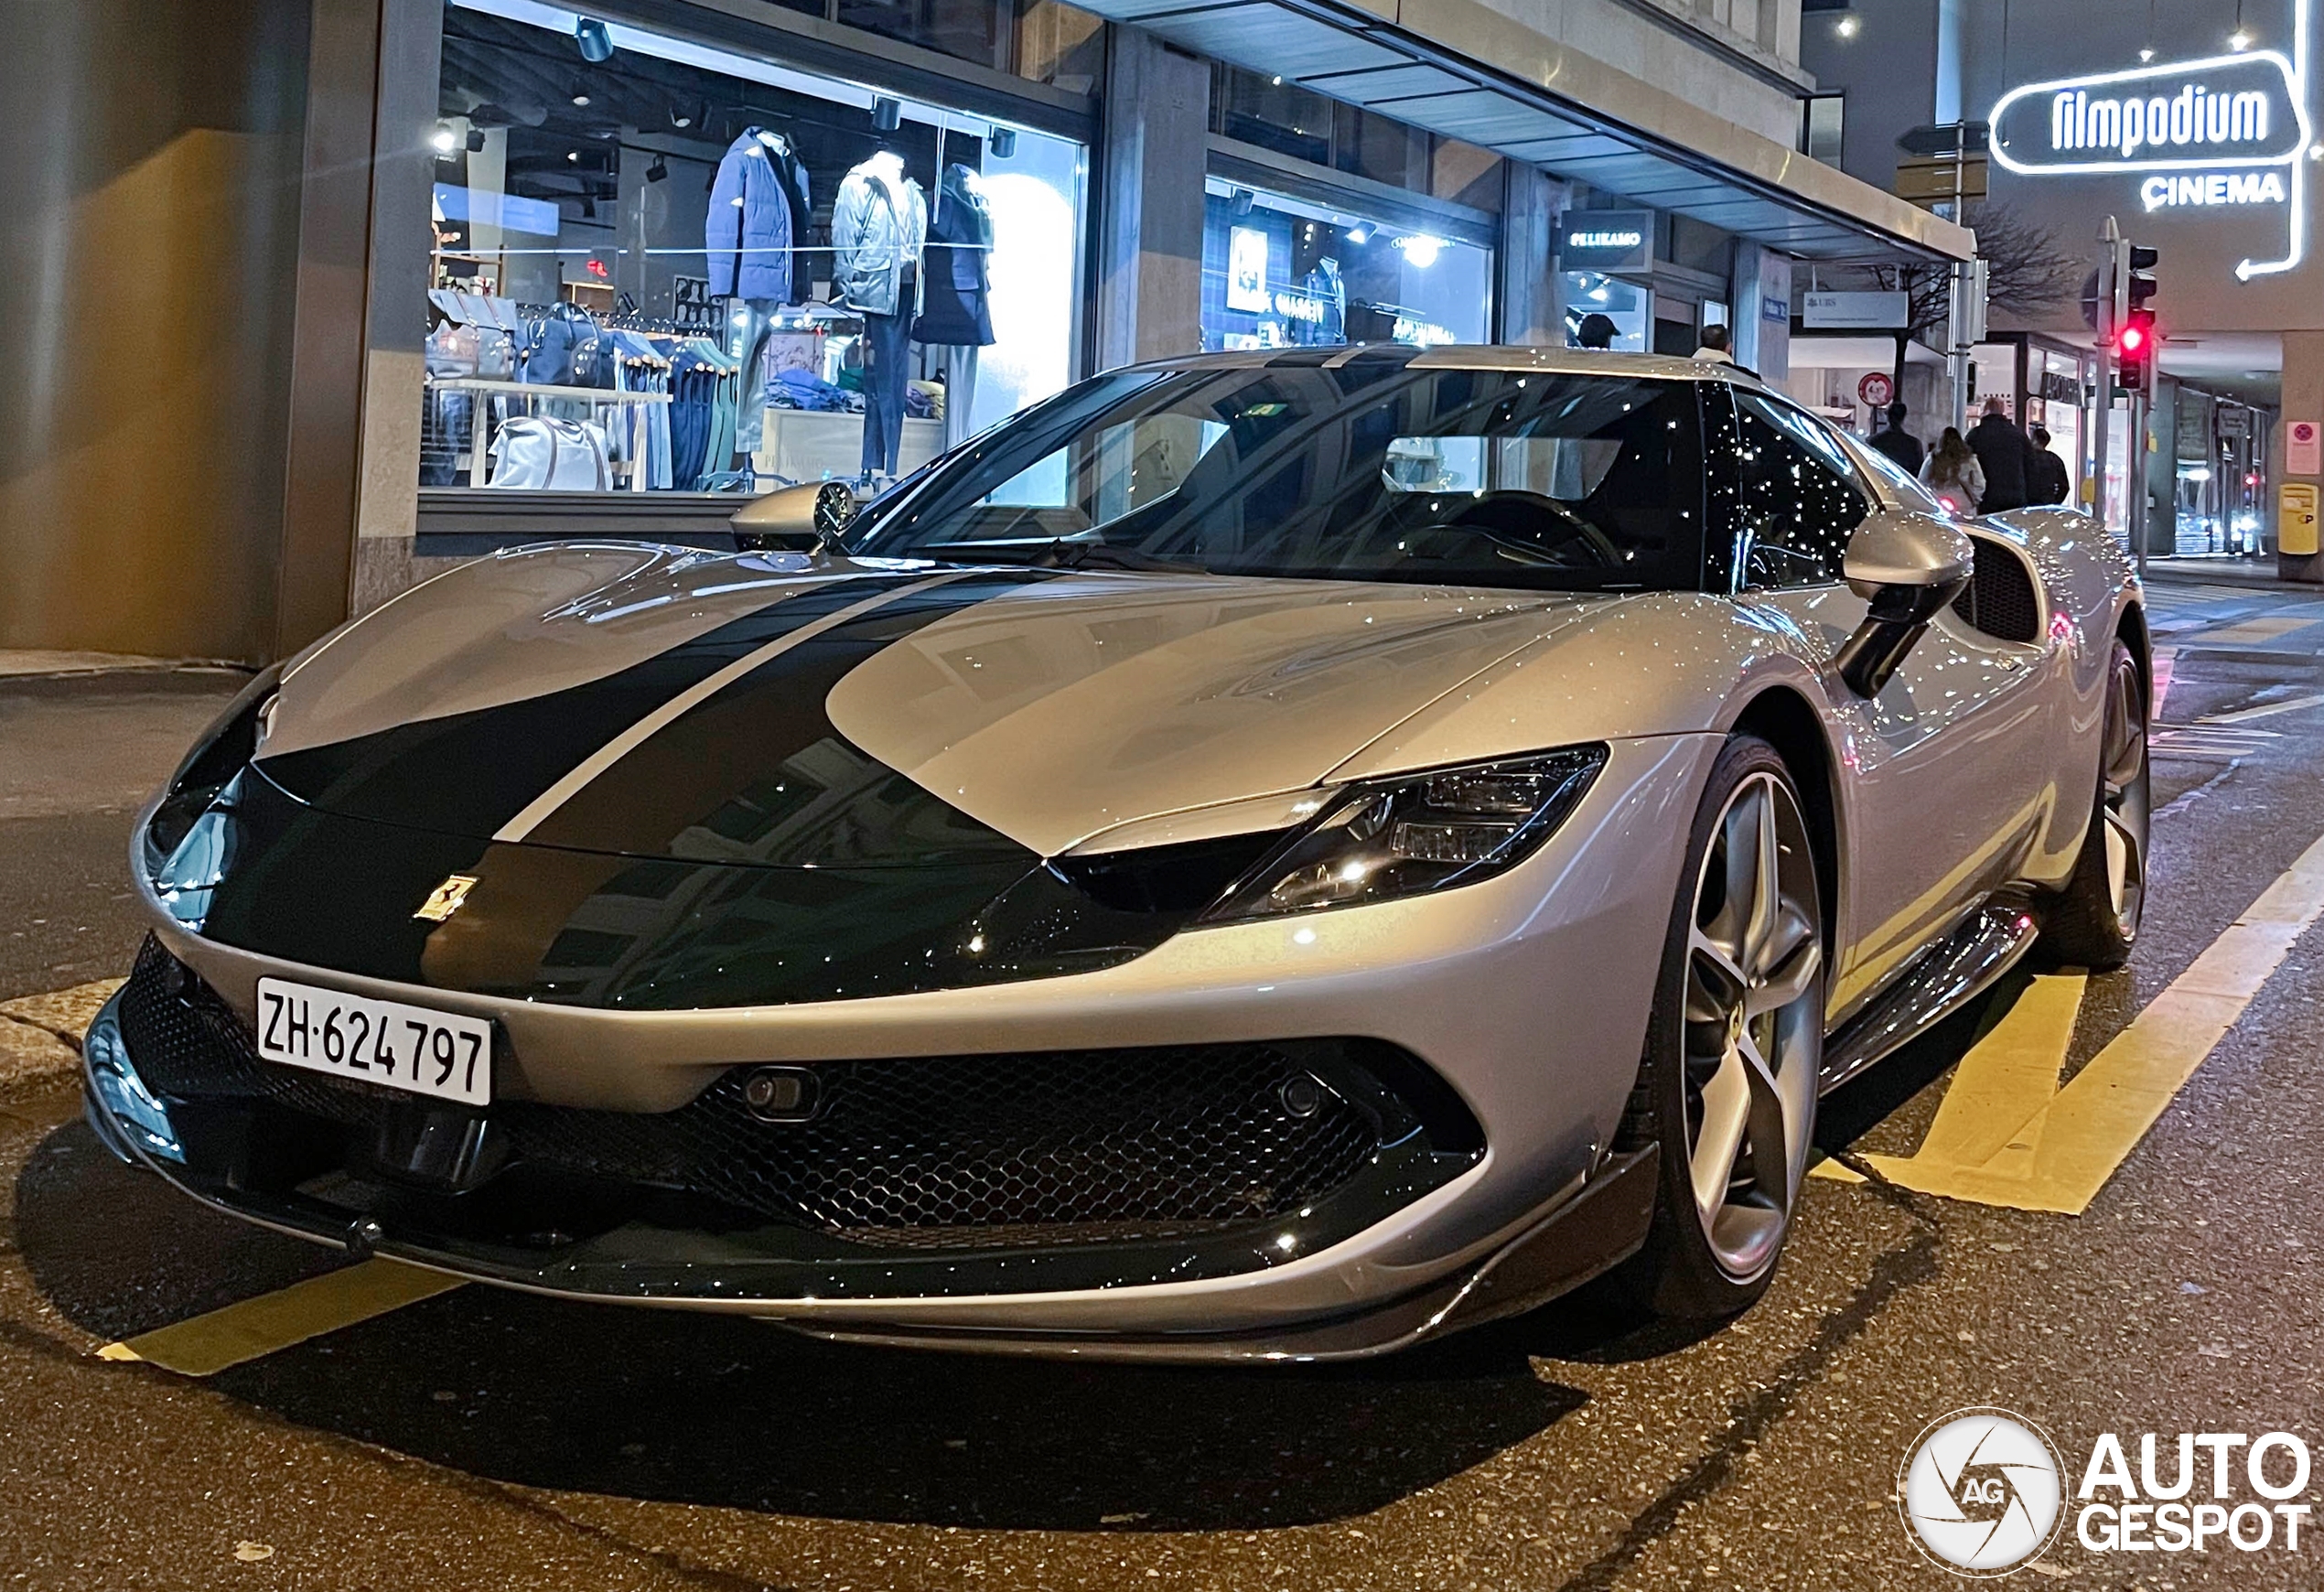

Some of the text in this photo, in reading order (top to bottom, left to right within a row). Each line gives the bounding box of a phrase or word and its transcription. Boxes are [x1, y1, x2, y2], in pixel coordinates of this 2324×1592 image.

[2051, 83, 2269, 158] filmpodium
[2140, 173, 2285, 209] CINEMA
[1570, 231, 1641, 246] PELIKAMO
[405, 1019, 483, 1093] 797
